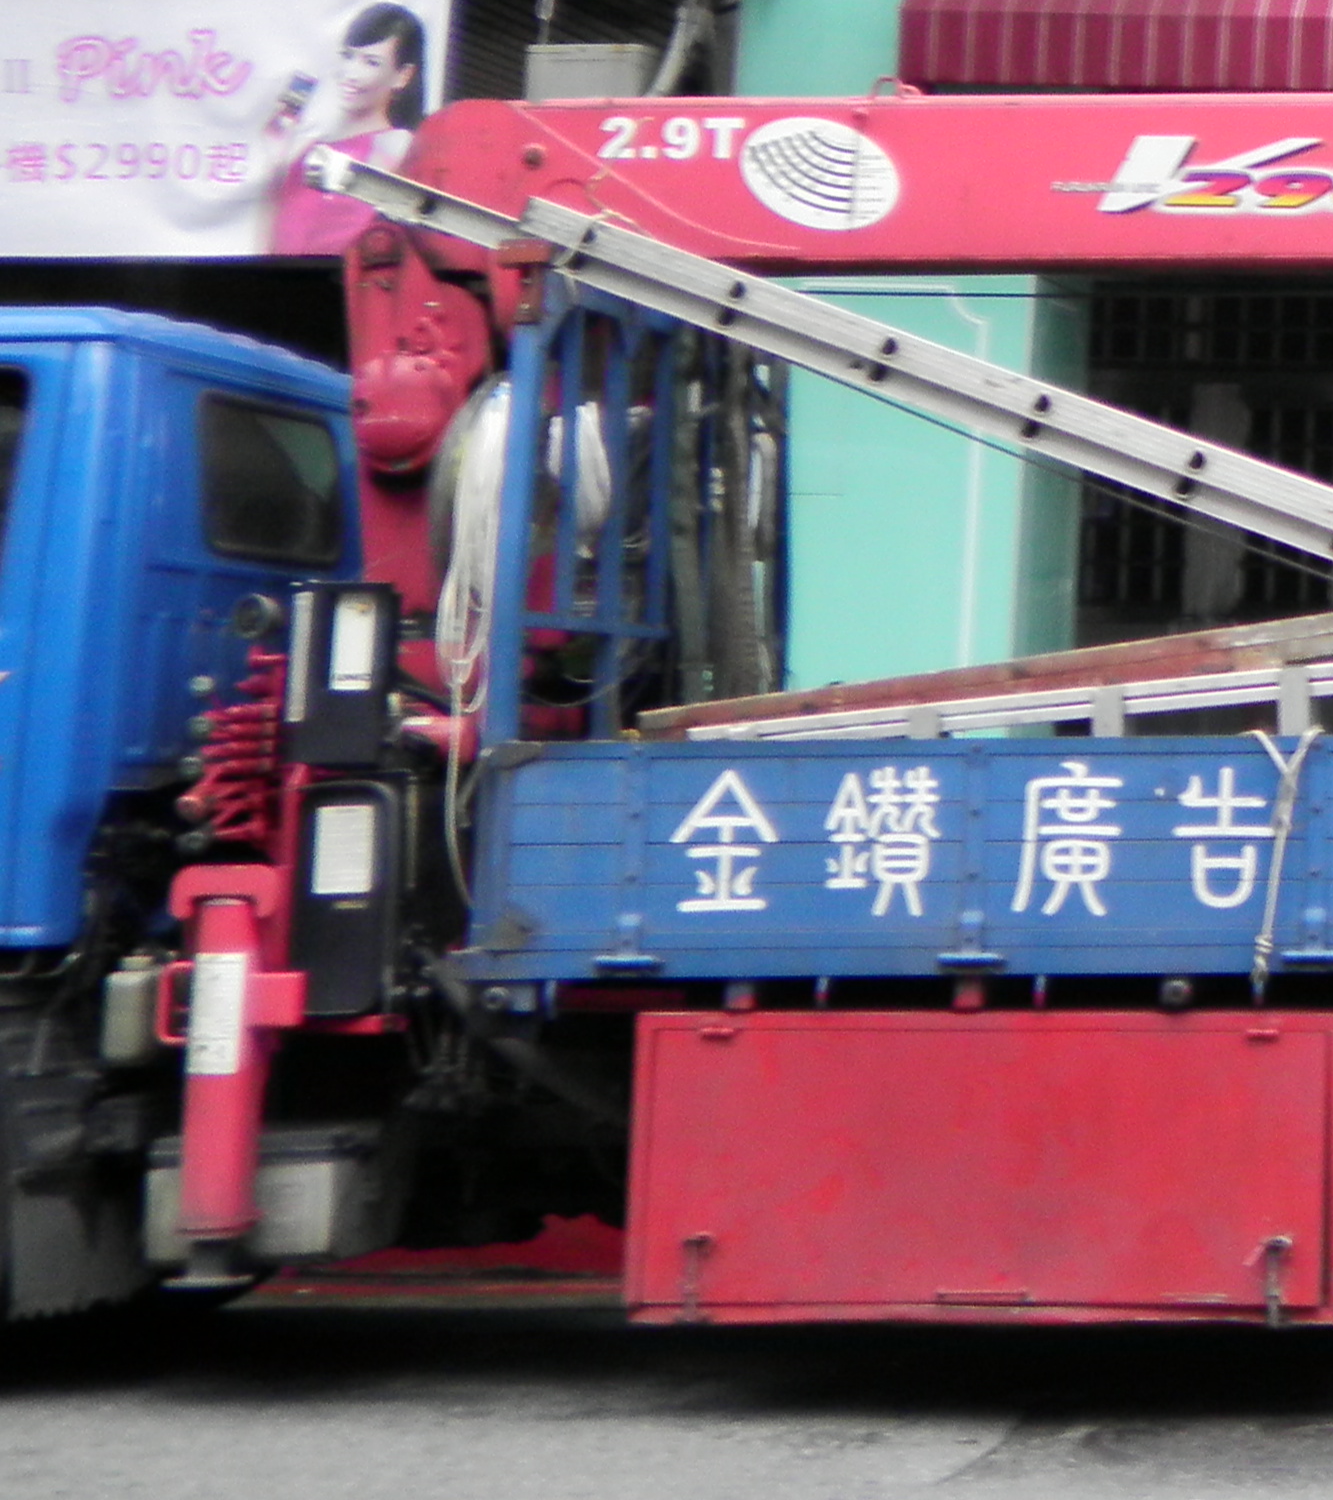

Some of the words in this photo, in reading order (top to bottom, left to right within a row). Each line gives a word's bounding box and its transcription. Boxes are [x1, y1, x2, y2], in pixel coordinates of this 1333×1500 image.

[55, 28, 254, 103] Pink
[597, 116, 747, 160] 2.9T
[669, 760, 1274, 918] 金鑽廣告
